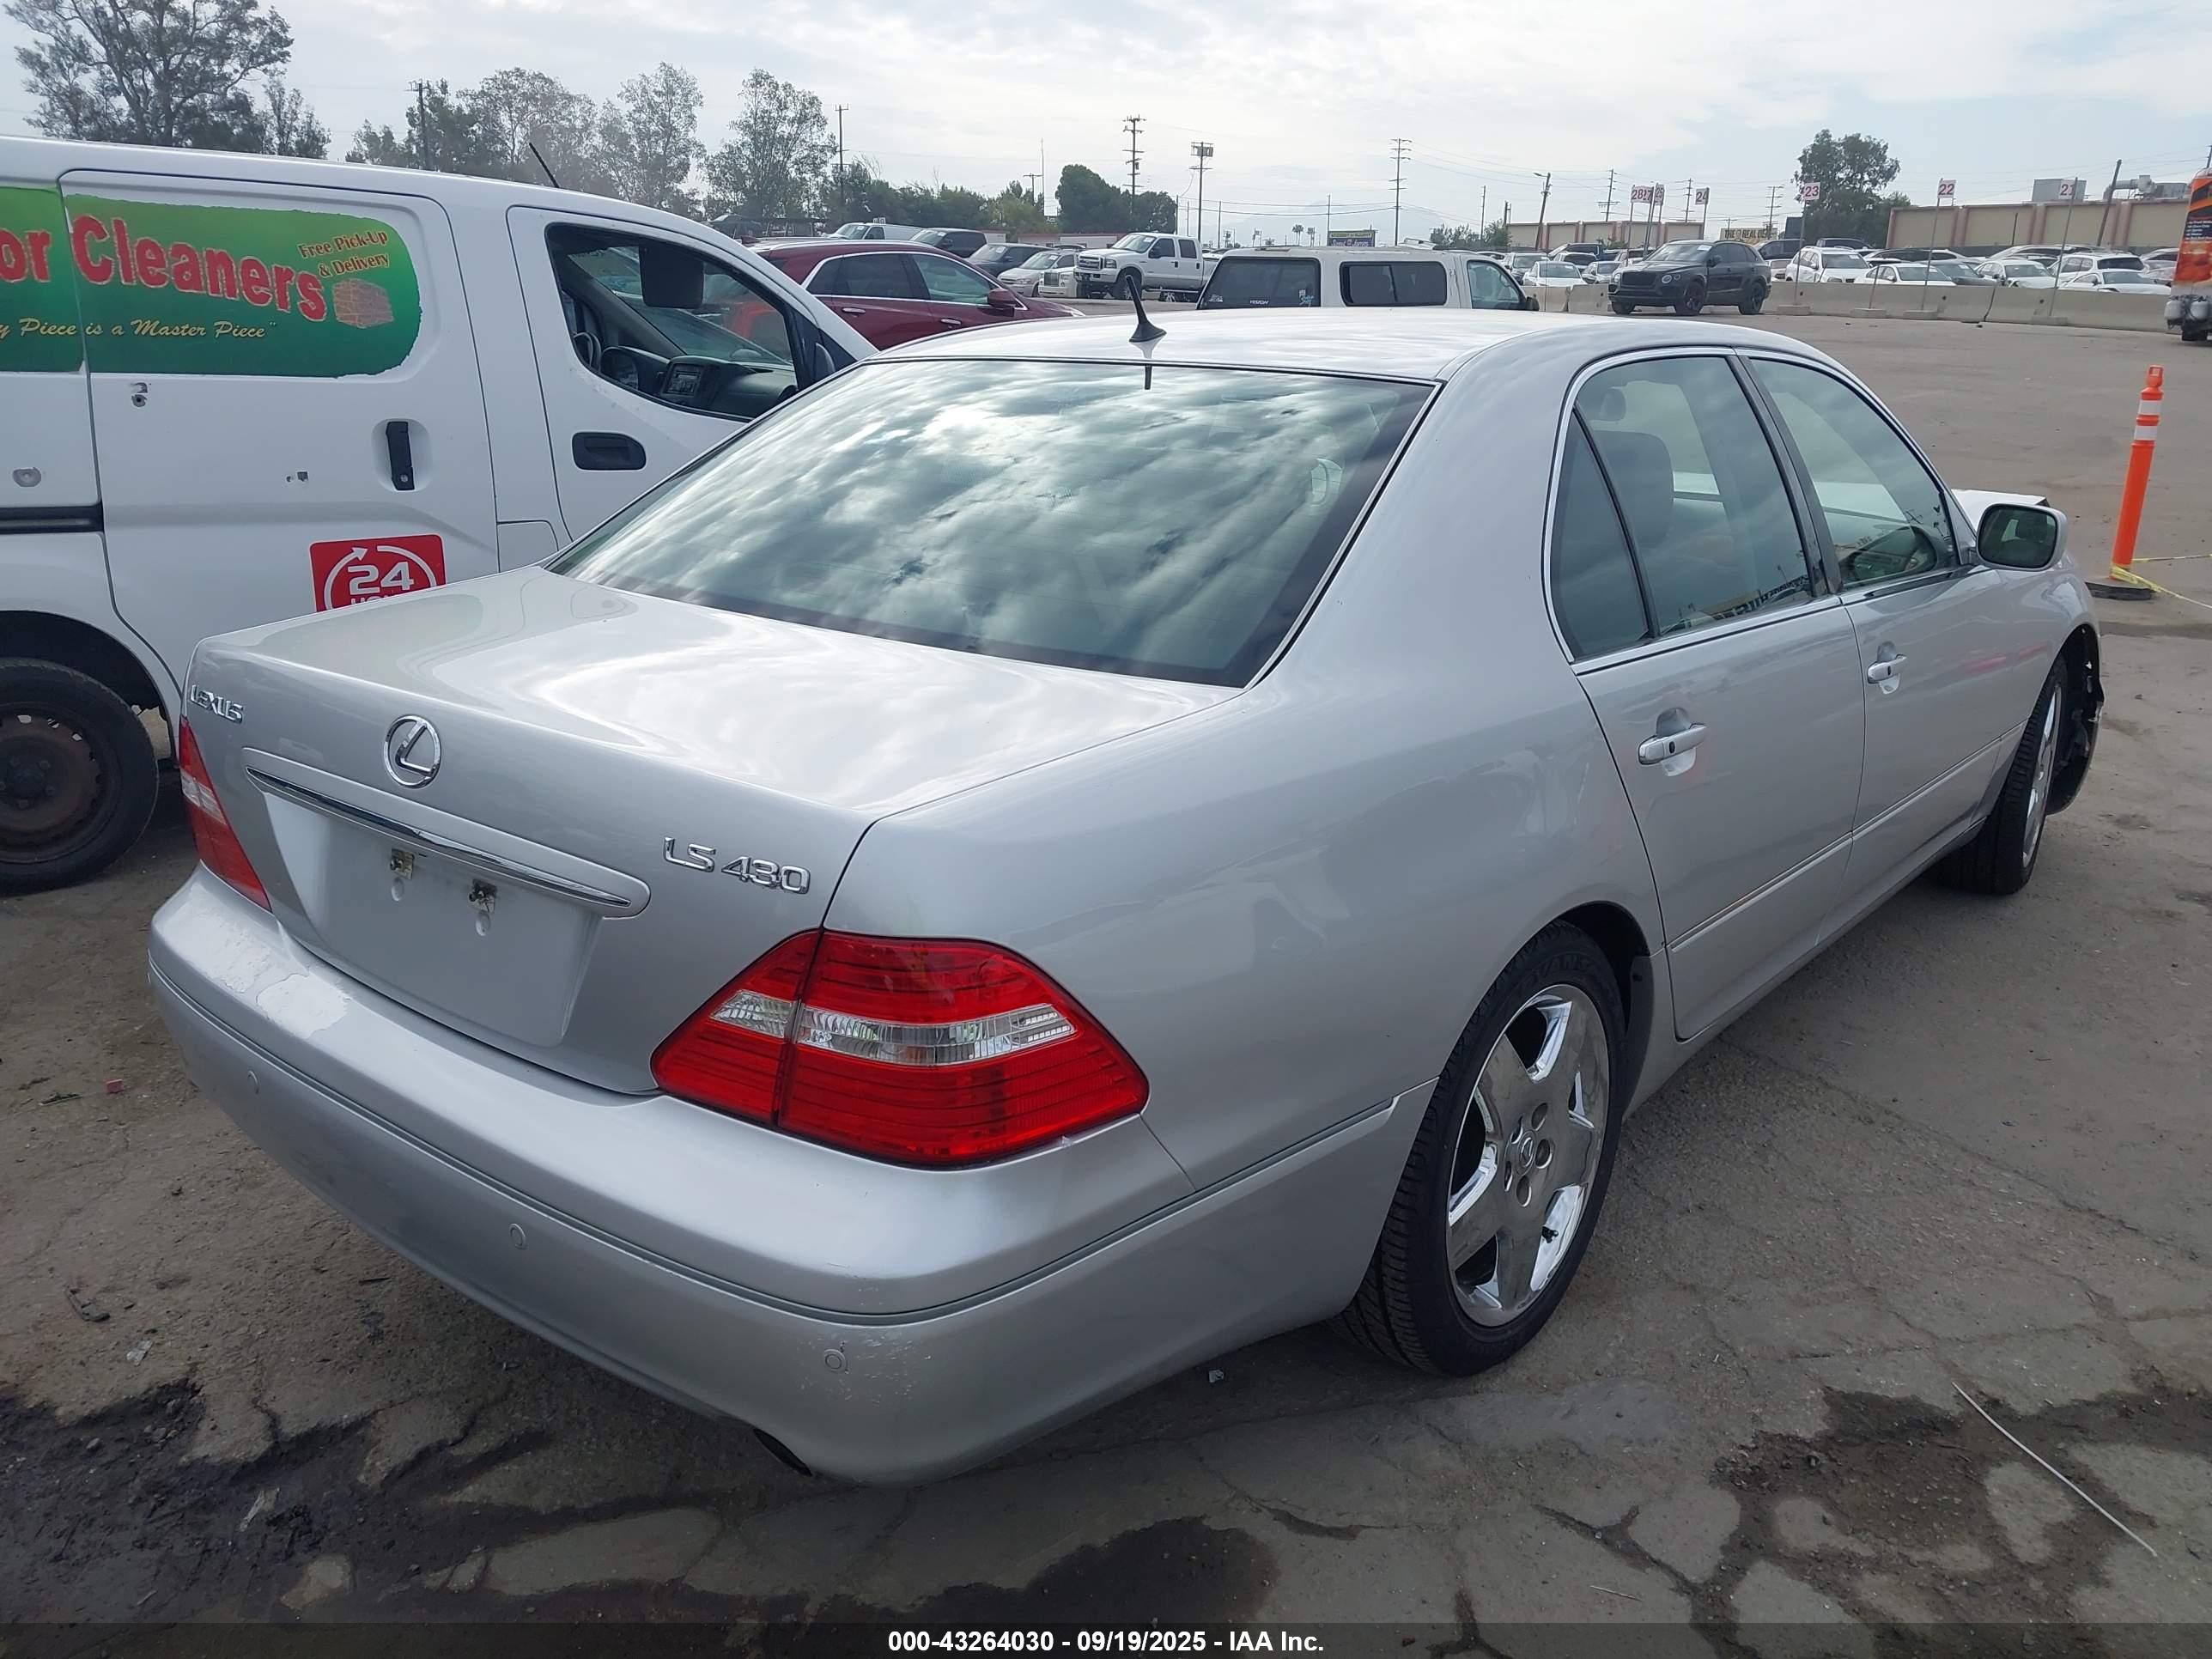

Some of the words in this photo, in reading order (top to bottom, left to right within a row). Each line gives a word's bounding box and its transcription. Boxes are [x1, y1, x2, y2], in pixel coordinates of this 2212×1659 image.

[1805, 186, 1818, 197] 23
[1939, 184, 1954, 196] 22
[2061, 185, 2075, 196] 21
[297, 242, 333, 258] Free
[333, 230, 389, 252] Pick-Up
[70, 215, 328, 322] Cleaners
[318, 262, 332, 278] &
[331, 253, 390, 275] Delivery
[19, 318, 76, 337] Piece
[85, 321, 103, 336] is
[112, 324, 125, 336] a
[131, 319, 206, 337] Master
[347, 561, 415, 596] 24
[190, 684, 243, 724] LEXUS
[663, 836, 716, 873] LS
[721, 855, 811, 895] 430
